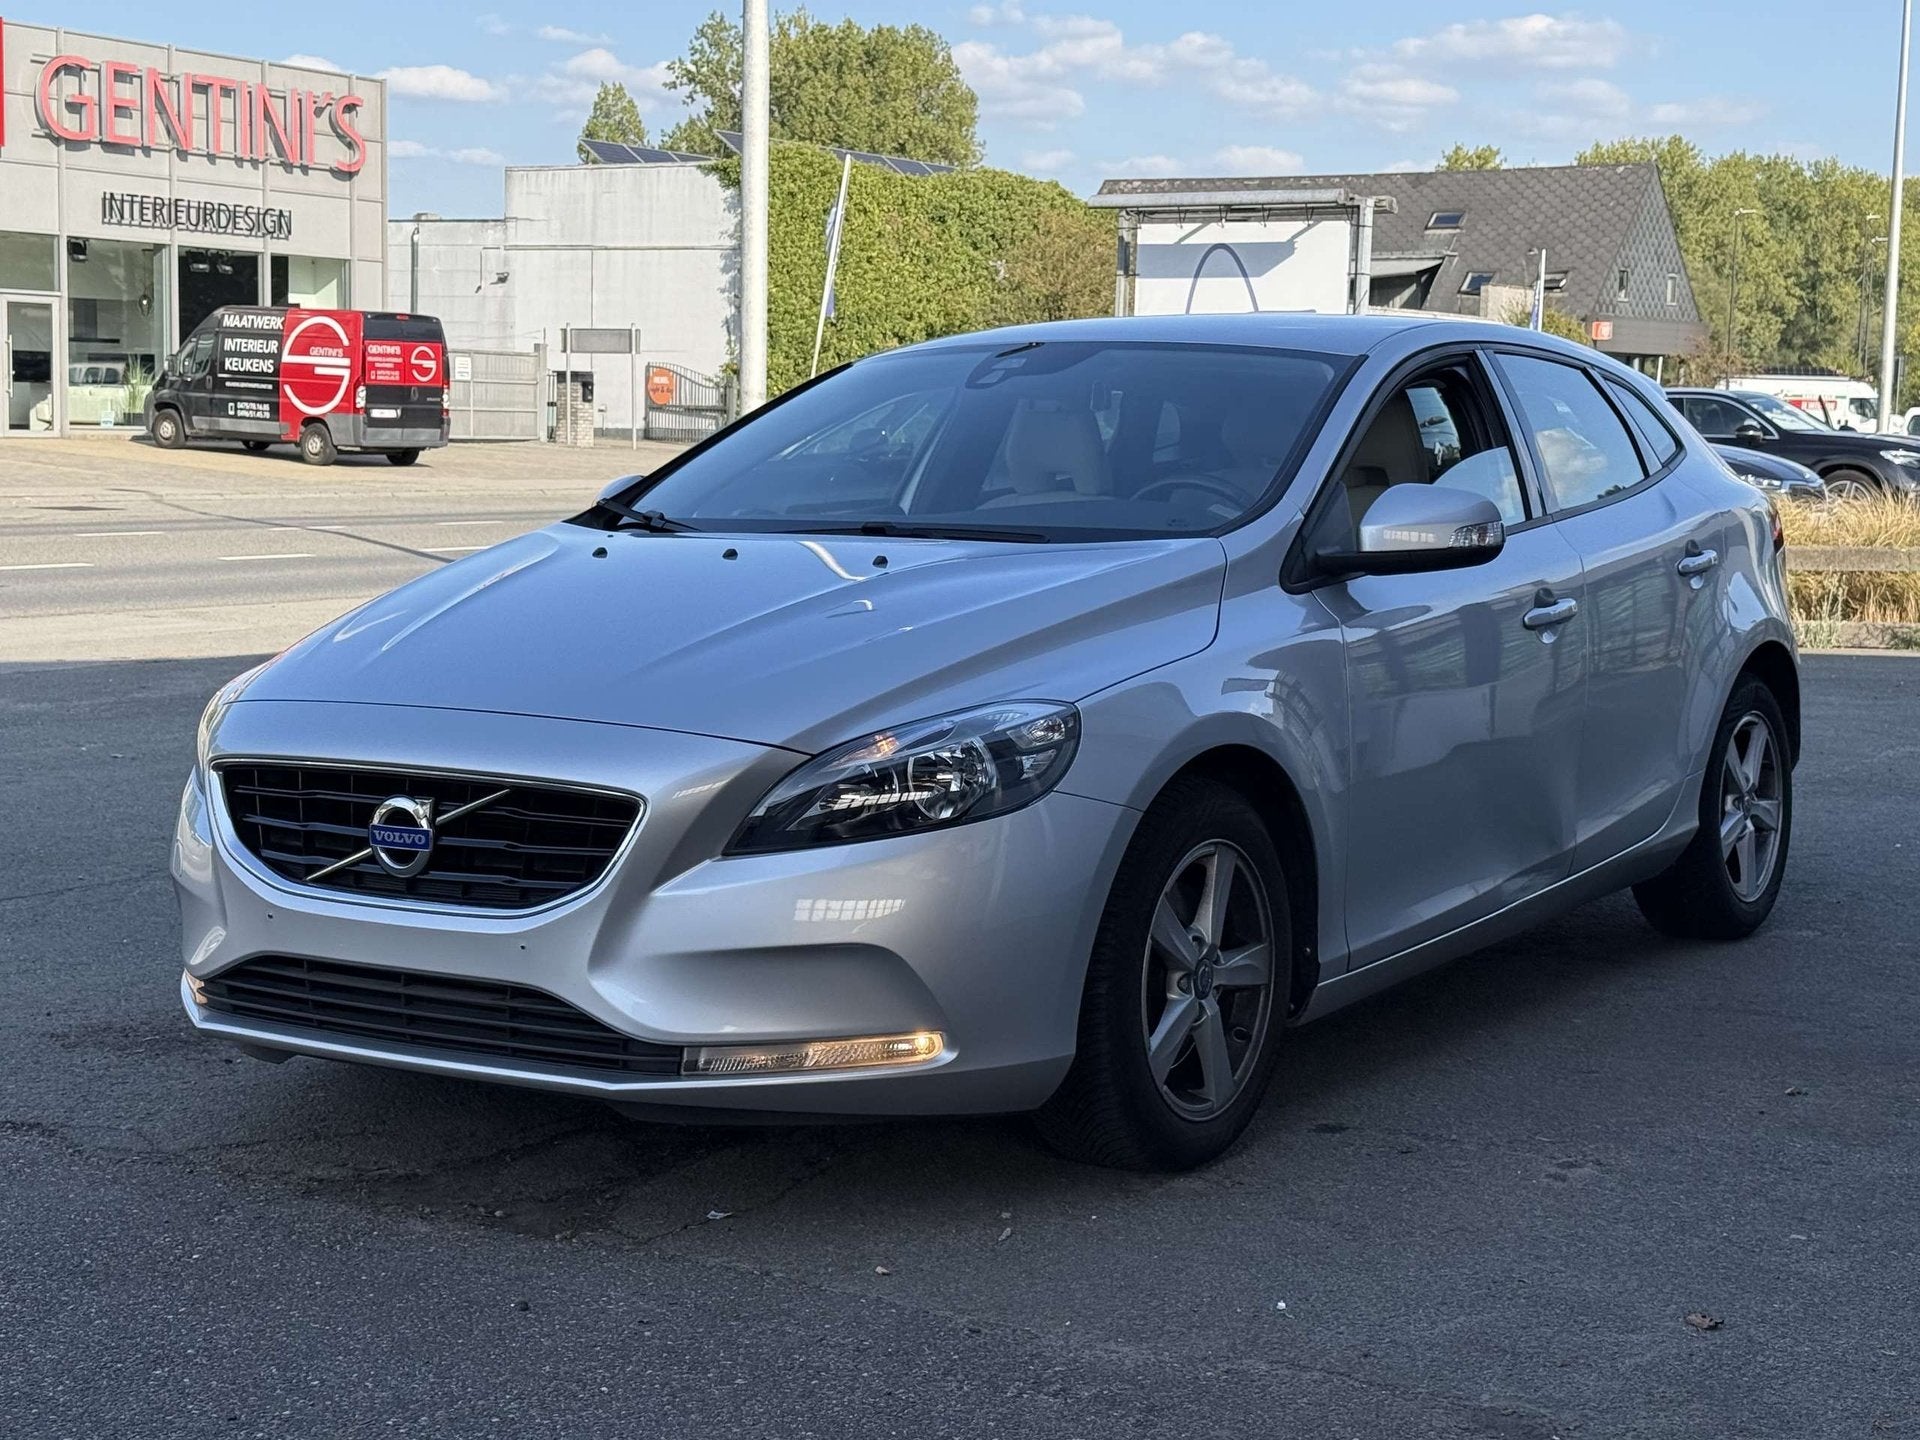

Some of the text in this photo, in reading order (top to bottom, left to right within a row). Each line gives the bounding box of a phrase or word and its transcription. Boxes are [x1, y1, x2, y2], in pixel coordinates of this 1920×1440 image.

[36, 55, 366, 172] GENTINI'S
[102, 191, 291, 235] INTERIEURDESIGN
[223, 314, 285, 330] MAATWERK
[224, 338, 278, 354] INTERIEUR
[309, 346, 344, 358] GENTINI'S
[367, 344, 402, 355] GENTINI'S
[224, 357, 275, 374] KEUKENS
[373, 829, 426, 845] VOLVO
